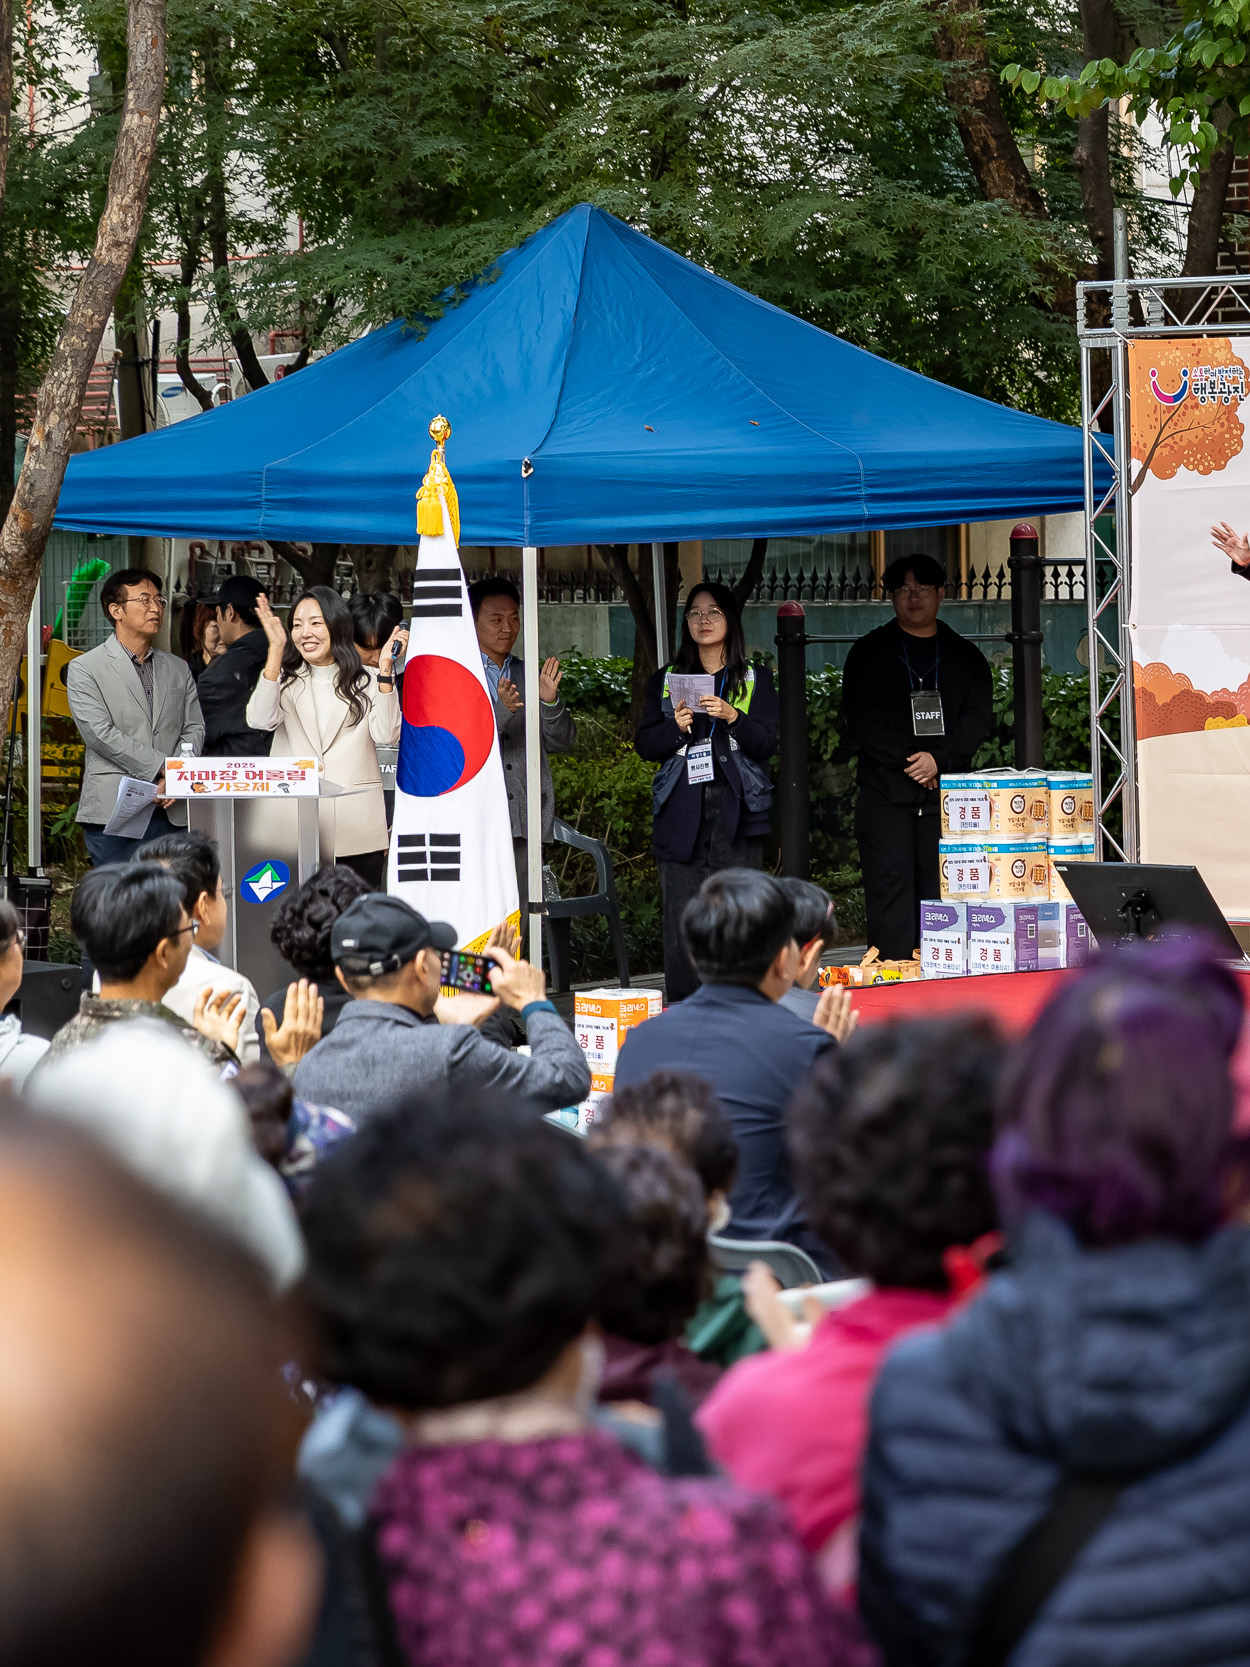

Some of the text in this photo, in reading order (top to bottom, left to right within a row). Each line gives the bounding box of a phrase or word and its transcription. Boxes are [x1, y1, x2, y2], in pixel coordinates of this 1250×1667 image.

[1218, 367, 1244, 381] 발전하는
[1192, 379, 1245, 404] 행복광진
[915, 711, 941, 720] STAFF
[379, 764, 397, 773] TAF
[177, 770, 306, 781] 자마장 어울림
[213, 782, 270, 792] 가요제
[925, 912, 949, 922] 크리넥스
[971, 913, 996, 923] 크리넥스
[575, 1002, 602, 1014] 크리넥스
[618, 1002, 646, 1013] 크리넥스
